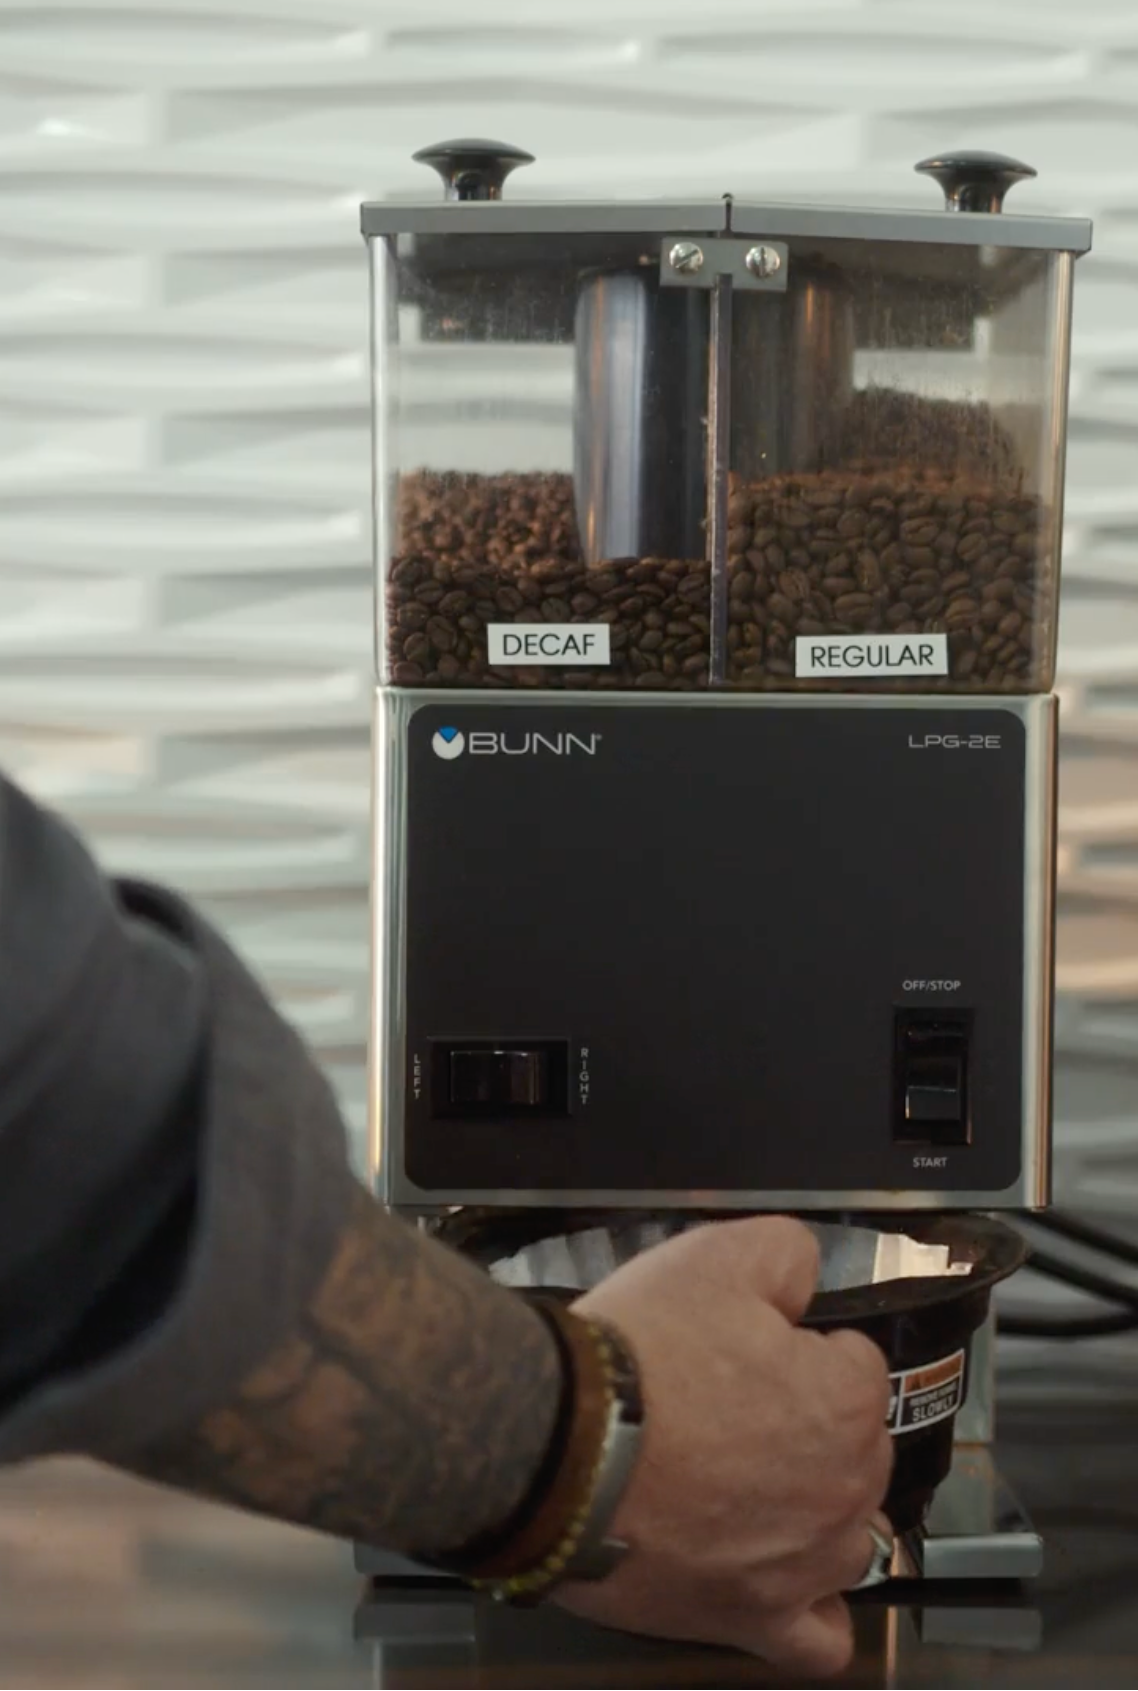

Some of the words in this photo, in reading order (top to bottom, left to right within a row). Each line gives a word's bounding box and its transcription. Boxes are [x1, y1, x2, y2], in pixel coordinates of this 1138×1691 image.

[502, 634, 596, 656] DECAF
[810, 645, 935, 668] REGULAR
[469, 732, 596, 755] BUNN
[908, 735, 1001, 749] LPG-2E
[902, 979, 961, 992] OFF/STOP
[413, 1054, 421, 1099] LEFT
[580, 1048, 589, 1104] RIGHT
[913, 1156, 948, 1169] START
